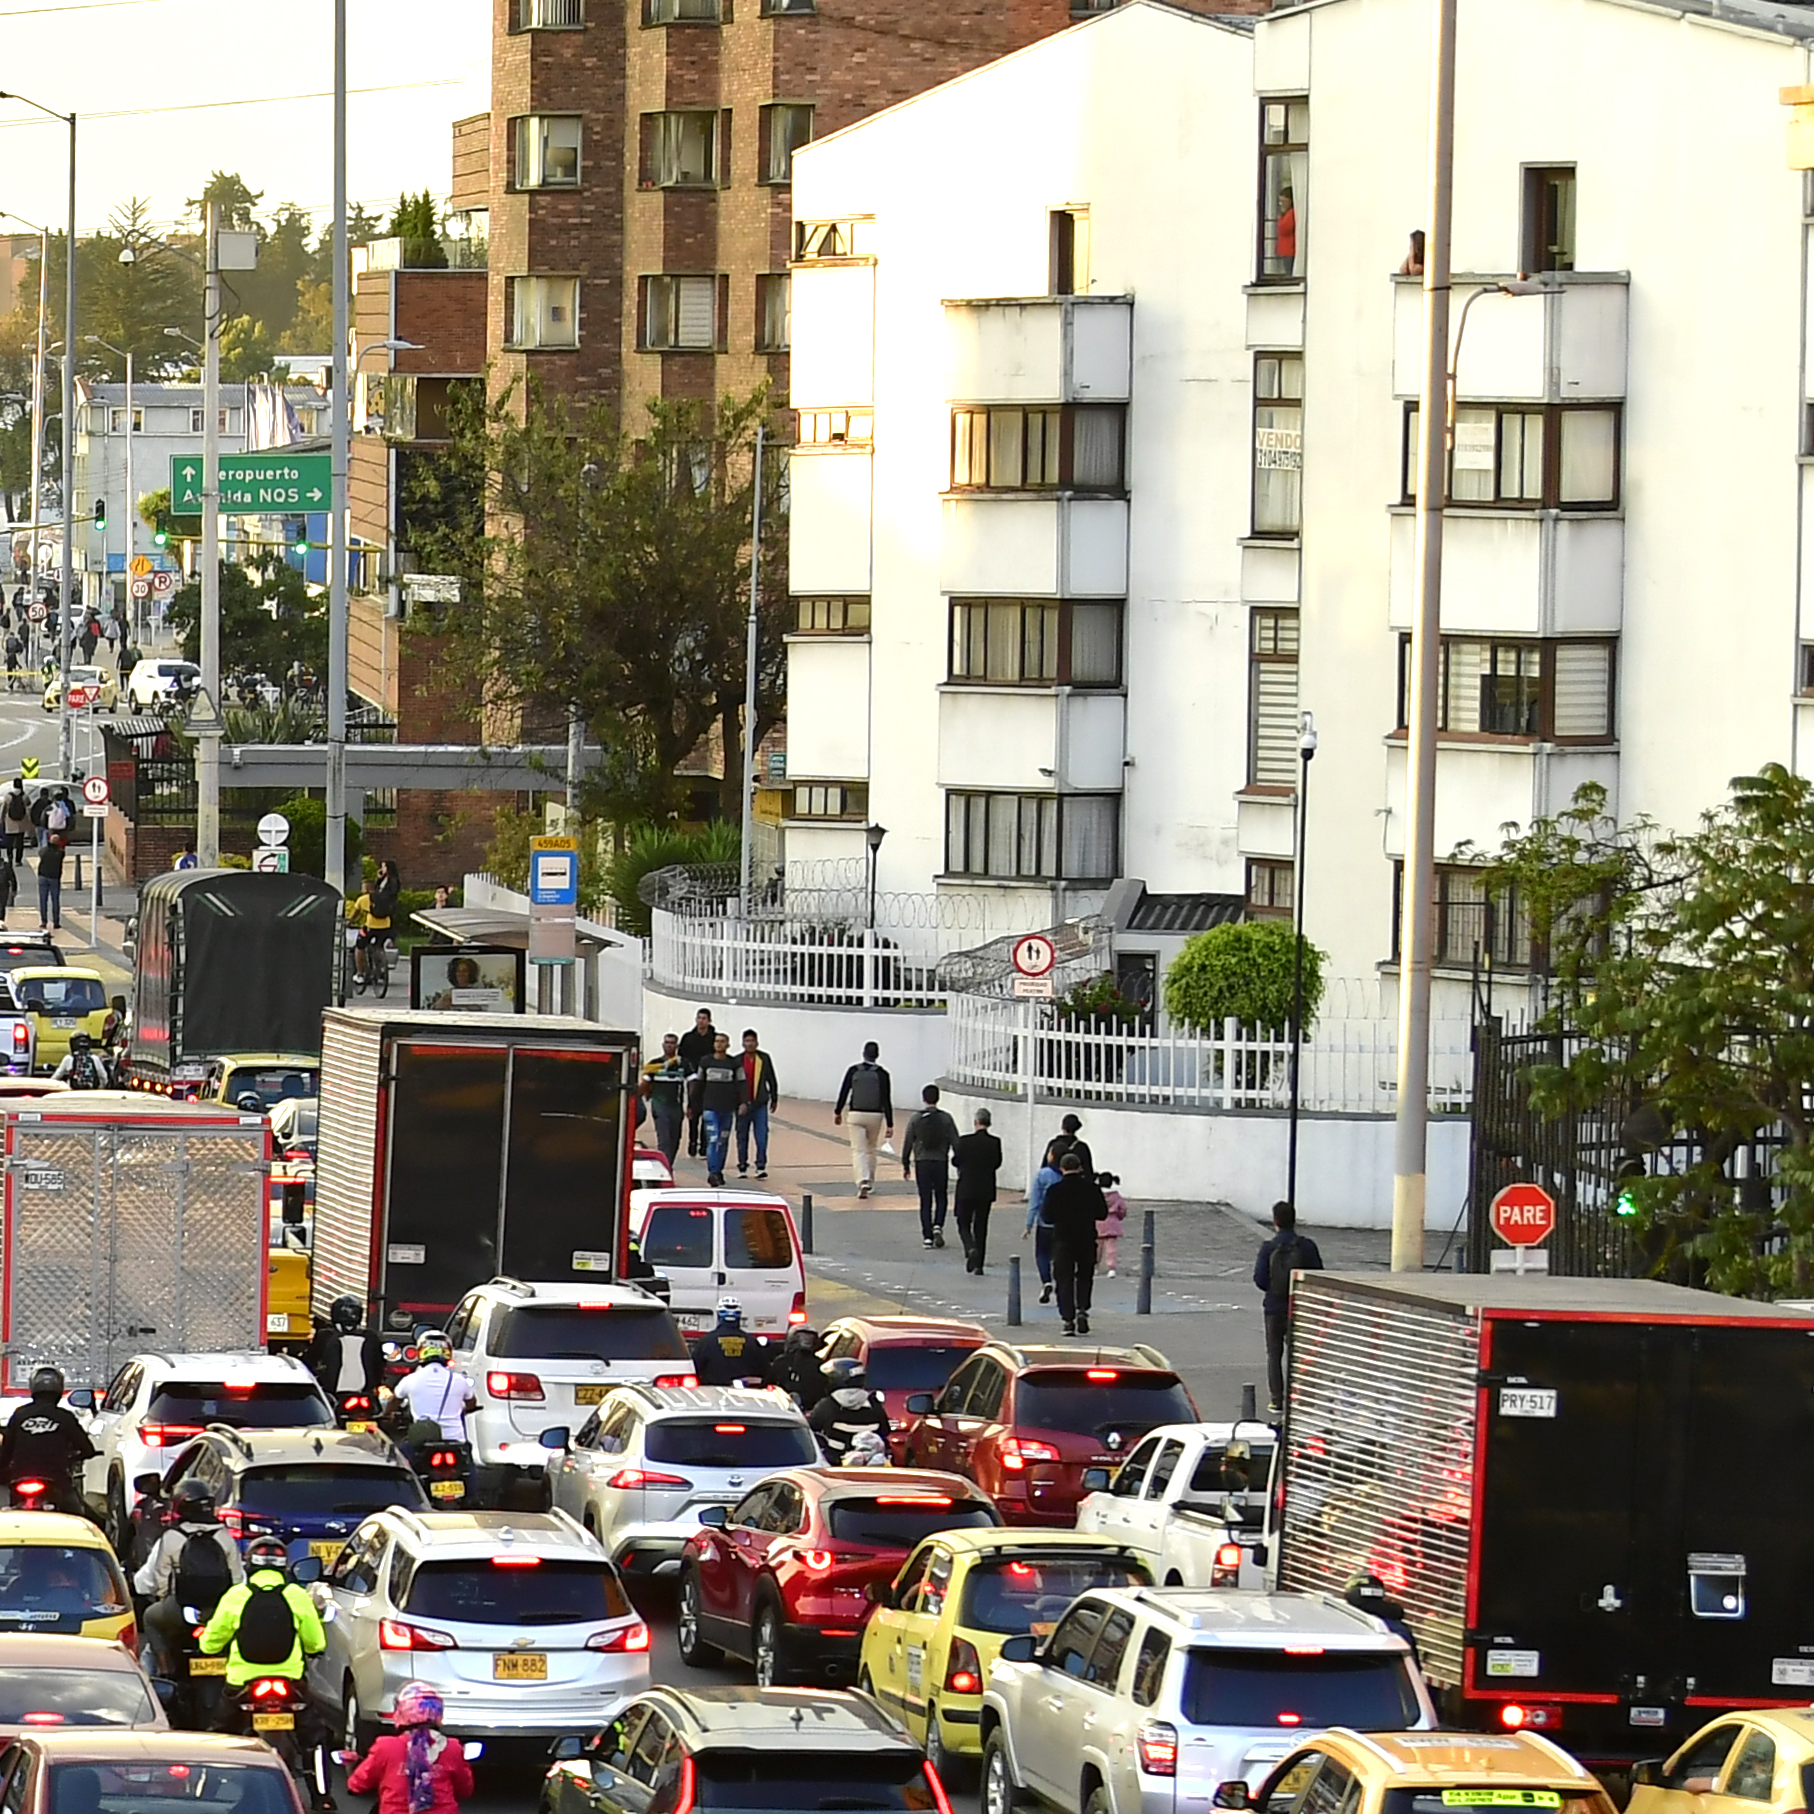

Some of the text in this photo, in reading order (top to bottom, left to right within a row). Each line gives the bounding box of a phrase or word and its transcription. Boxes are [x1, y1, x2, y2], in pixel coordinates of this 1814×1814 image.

[219, 467, 299, 484] eropuerto
[259, 488, 299, 504] NQS
[31, 604, 45, 616] 50
[1499, 1205, 1548, 1226] PARE
